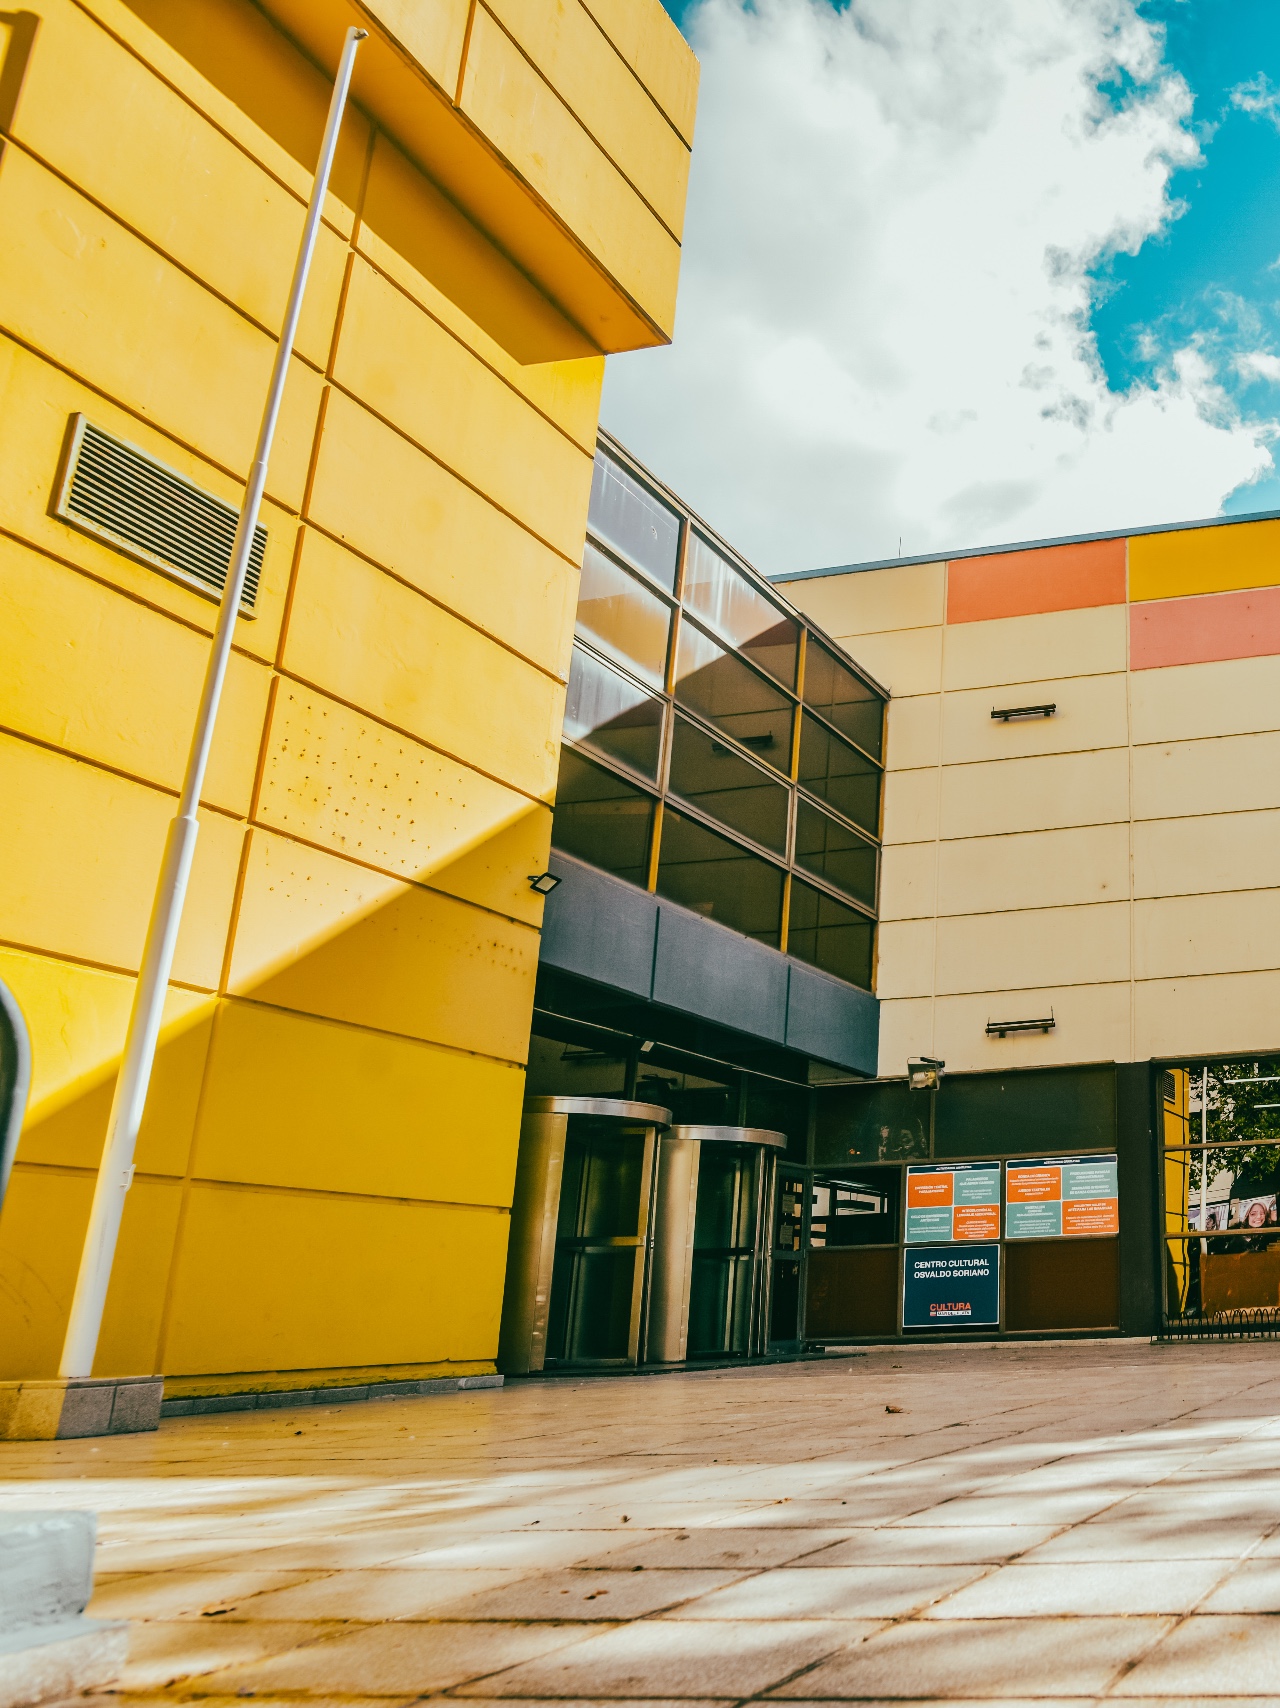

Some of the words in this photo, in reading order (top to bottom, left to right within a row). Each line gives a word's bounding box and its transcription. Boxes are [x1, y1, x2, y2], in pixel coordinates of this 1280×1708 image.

[948, 1259, 989, 1267] CULTURAL
[914, 1270, 951, 1278] OSVALDO
[953, 1269, 989, 1277] SORIANO
[930, 1303, 971, 1311] CULTURA
